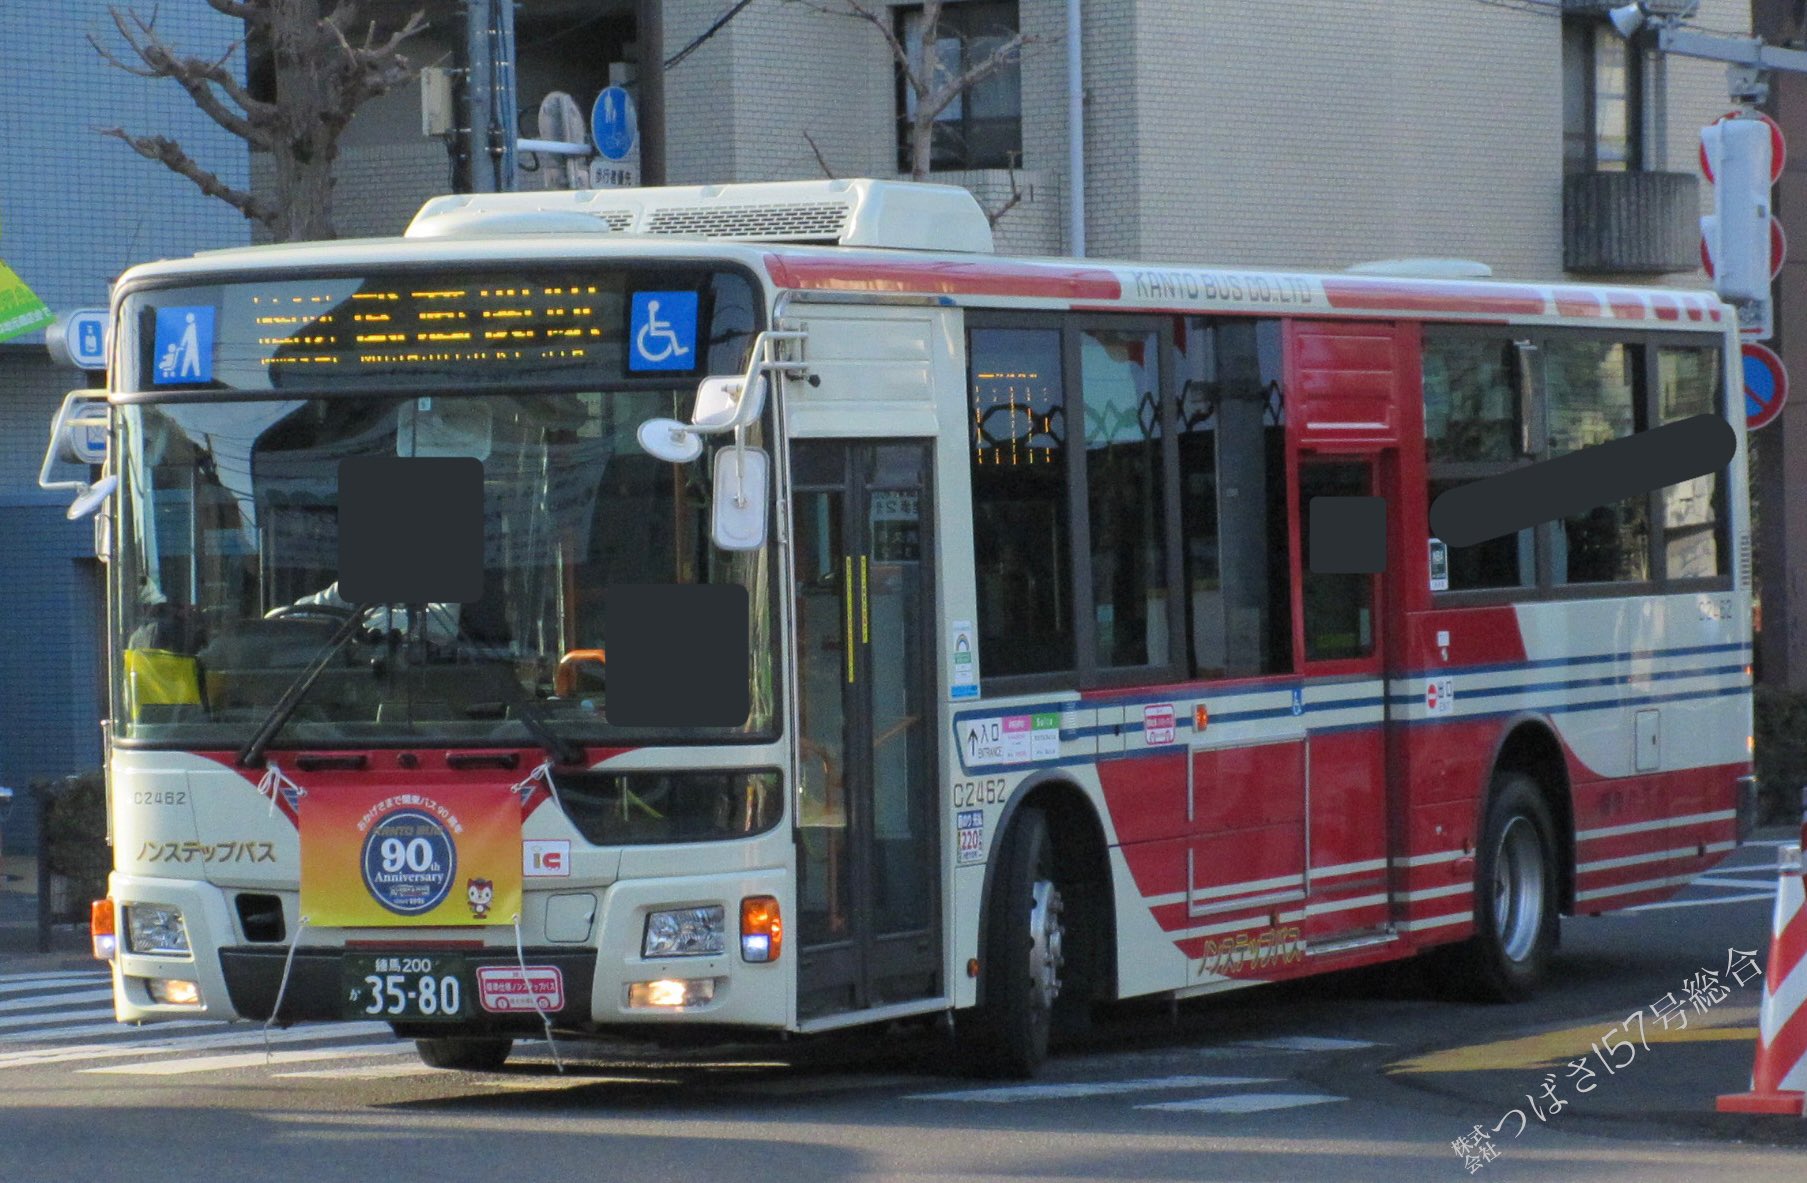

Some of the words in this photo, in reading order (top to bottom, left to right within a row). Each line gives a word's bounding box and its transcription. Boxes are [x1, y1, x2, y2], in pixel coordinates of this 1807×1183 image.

[1132, 271, 1198, 299] KANTO
[1200, 273, 1243, 300] BUS
[981, 723, 999, 743] 入口
[134, 791, 187, 805] C2462
[954, 779, 1006, 808] C2462
[136, 840, 276, 863] ノンステップバス
[961, 831, 978, 850] 220
[374, 872, 445, 885] Anniversary
[1197, 926, 1301, 977] ノンステップバス
[364, 975, 460, 1015] 35-80
